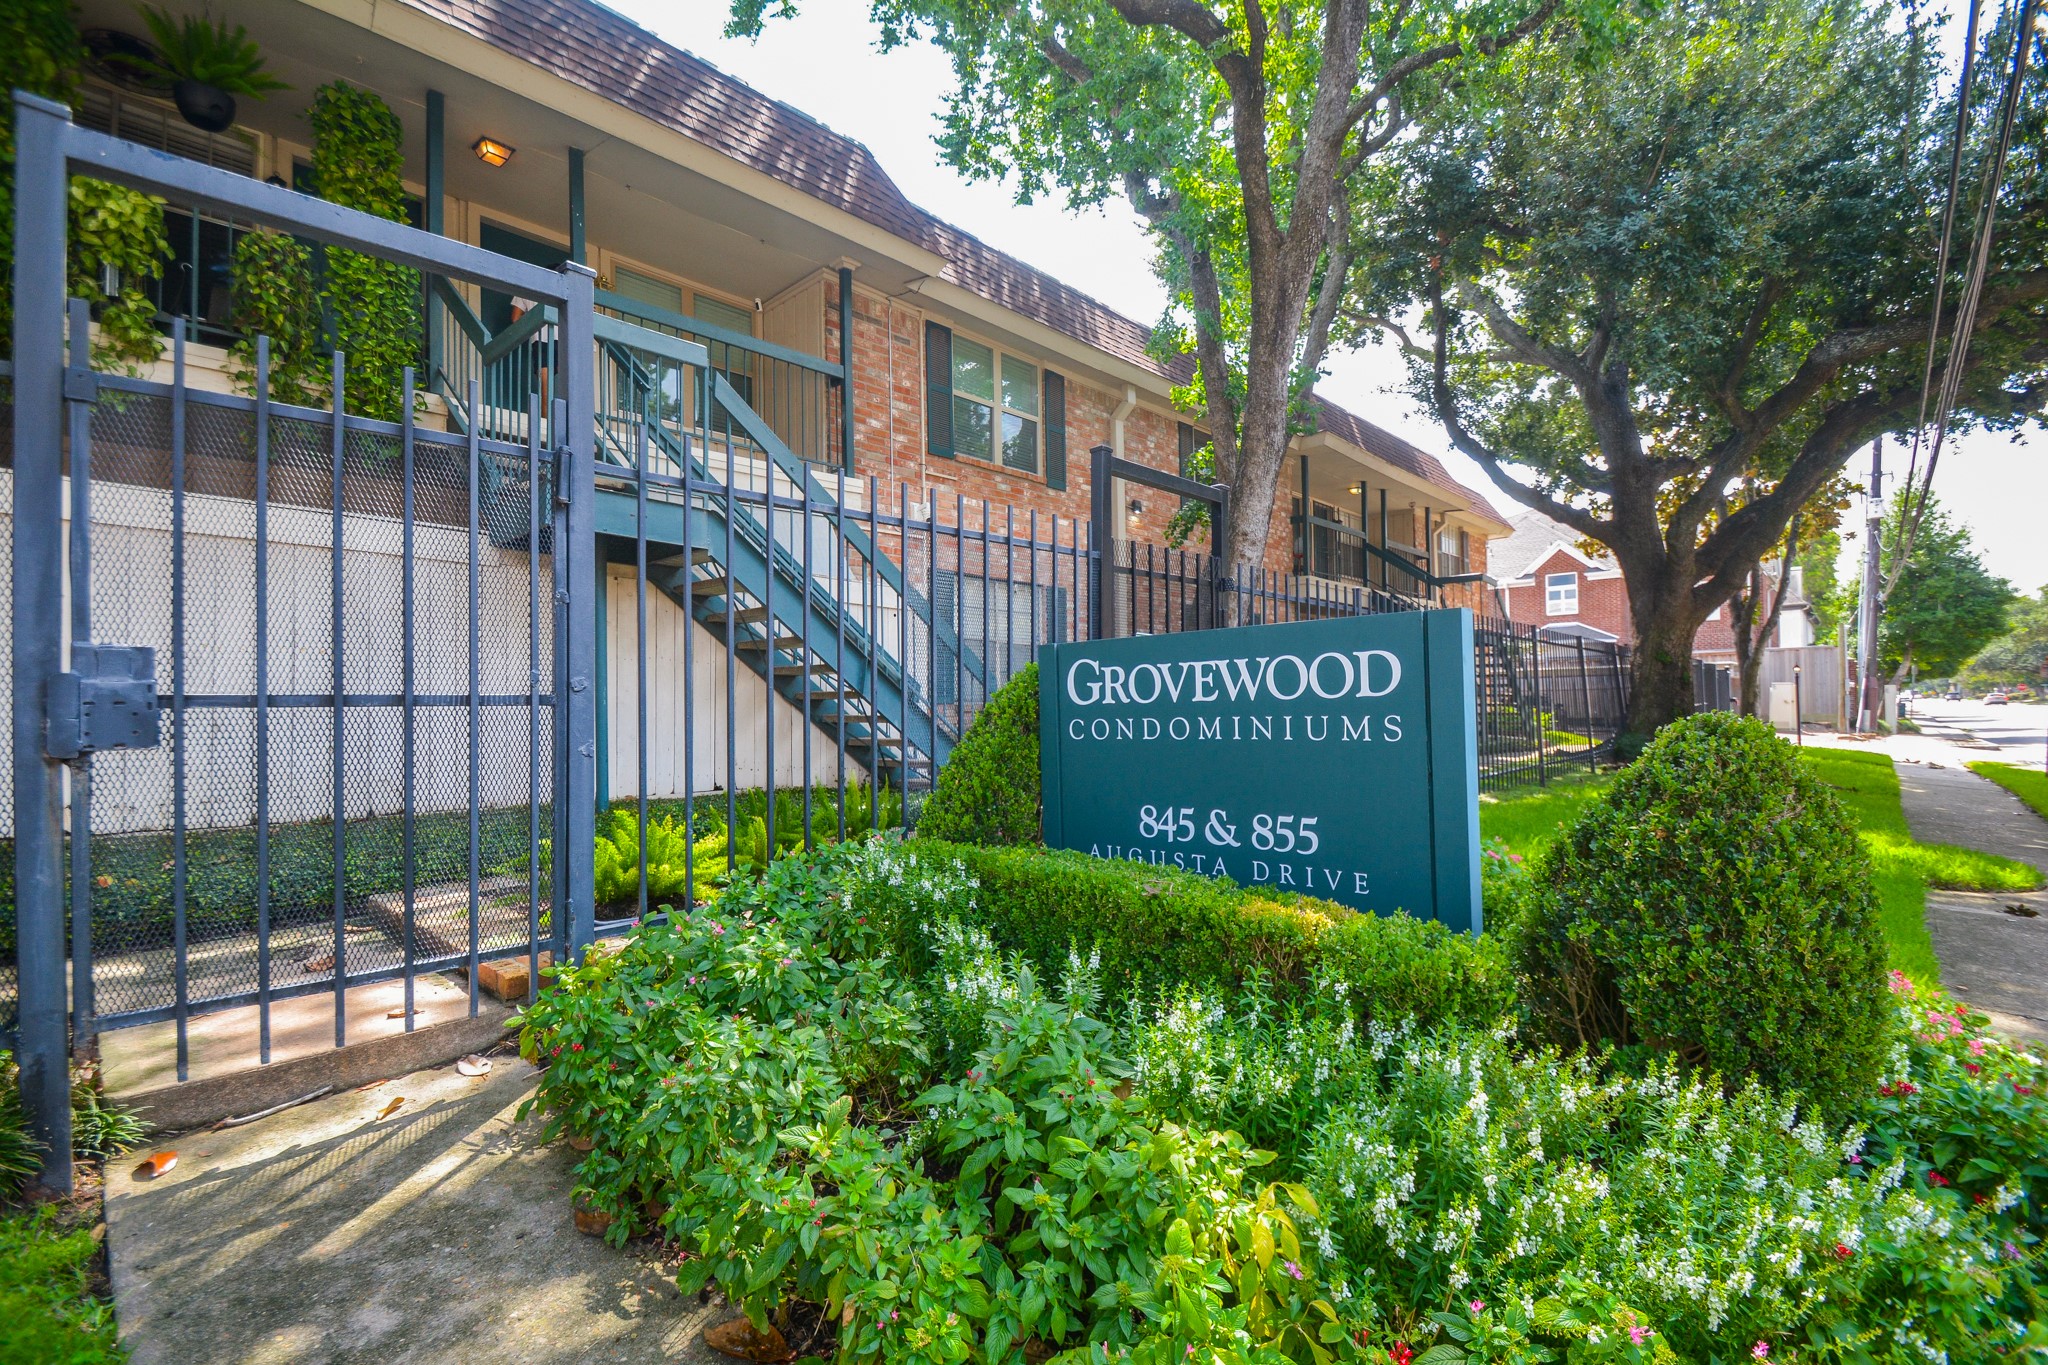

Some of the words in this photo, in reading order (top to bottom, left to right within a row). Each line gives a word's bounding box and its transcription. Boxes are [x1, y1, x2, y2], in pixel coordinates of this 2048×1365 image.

[1067, 650, 1402, 706] GROVEWOOD
[1069, 715, 1403, 743] CONDOMINIUMS
[1139, 804, 1195, 842] 845
[1204, 809, 1241, 847] &
[1251, 814, 1319, 855] 855
[1252, 860, 1370, 895] DRIVE
